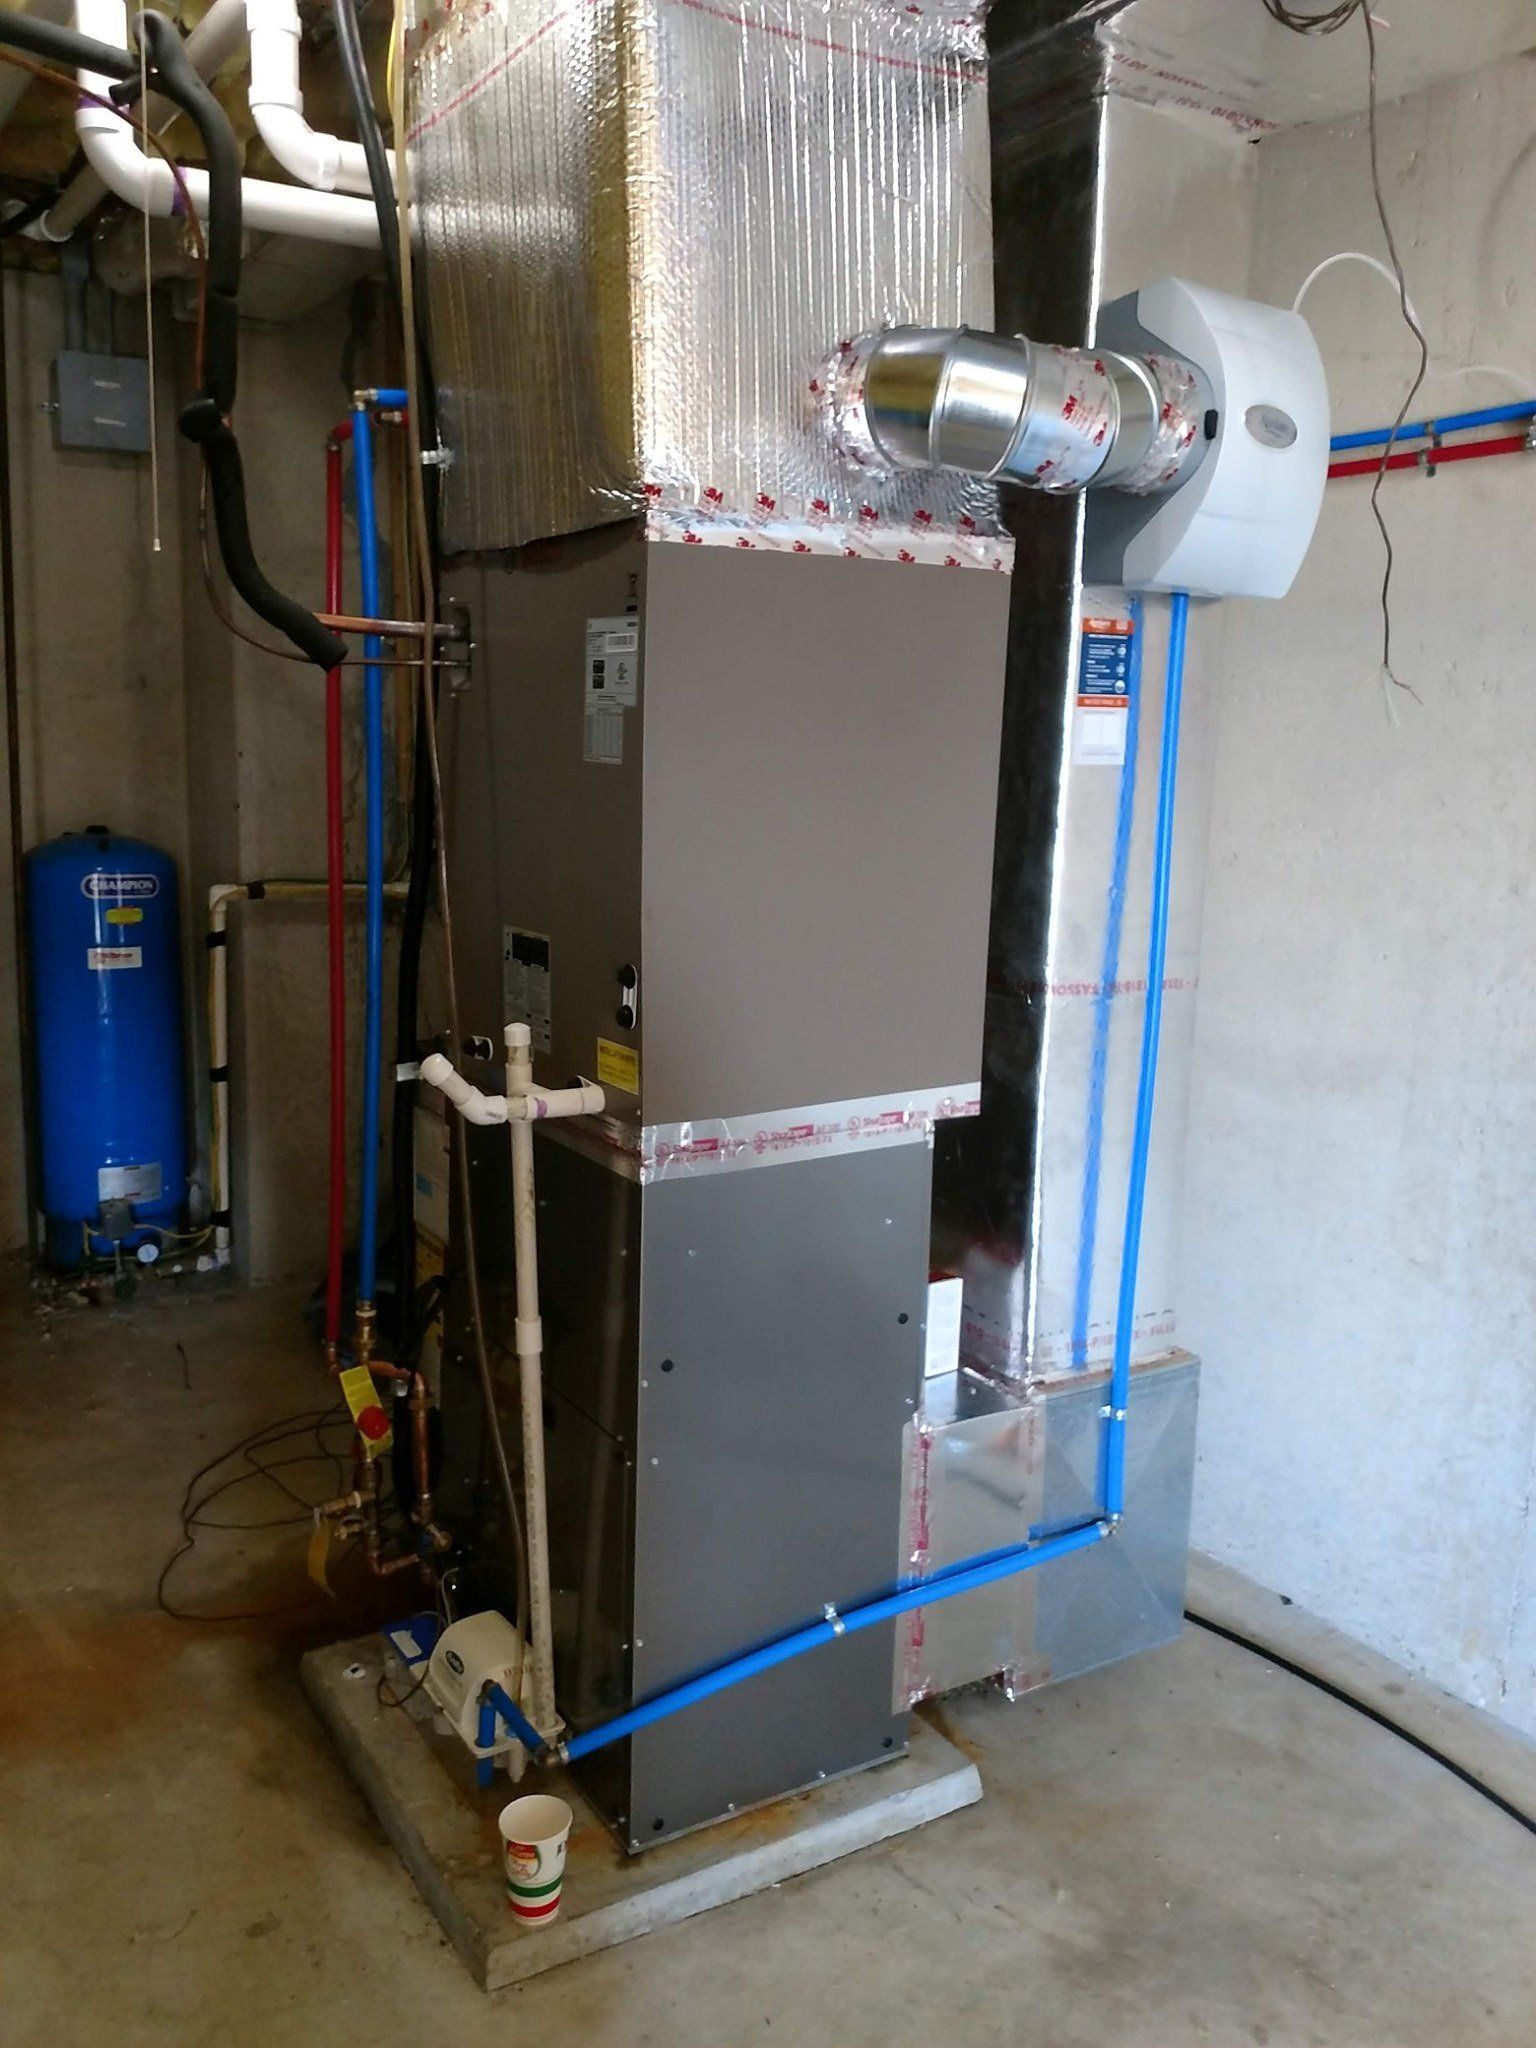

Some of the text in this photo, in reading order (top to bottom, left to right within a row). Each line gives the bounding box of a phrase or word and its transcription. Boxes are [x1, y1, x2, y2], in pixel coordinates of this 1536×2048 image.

[1062, 394, 1077, 420] 3M
[704, 486, 724, 503] 3M
[756, 492, 776, 511] 3M
[812, 498, 830, 513] 3M
[914, 509, 932, 524] 3M
[90, 880, 154, 890] CHAMPION
